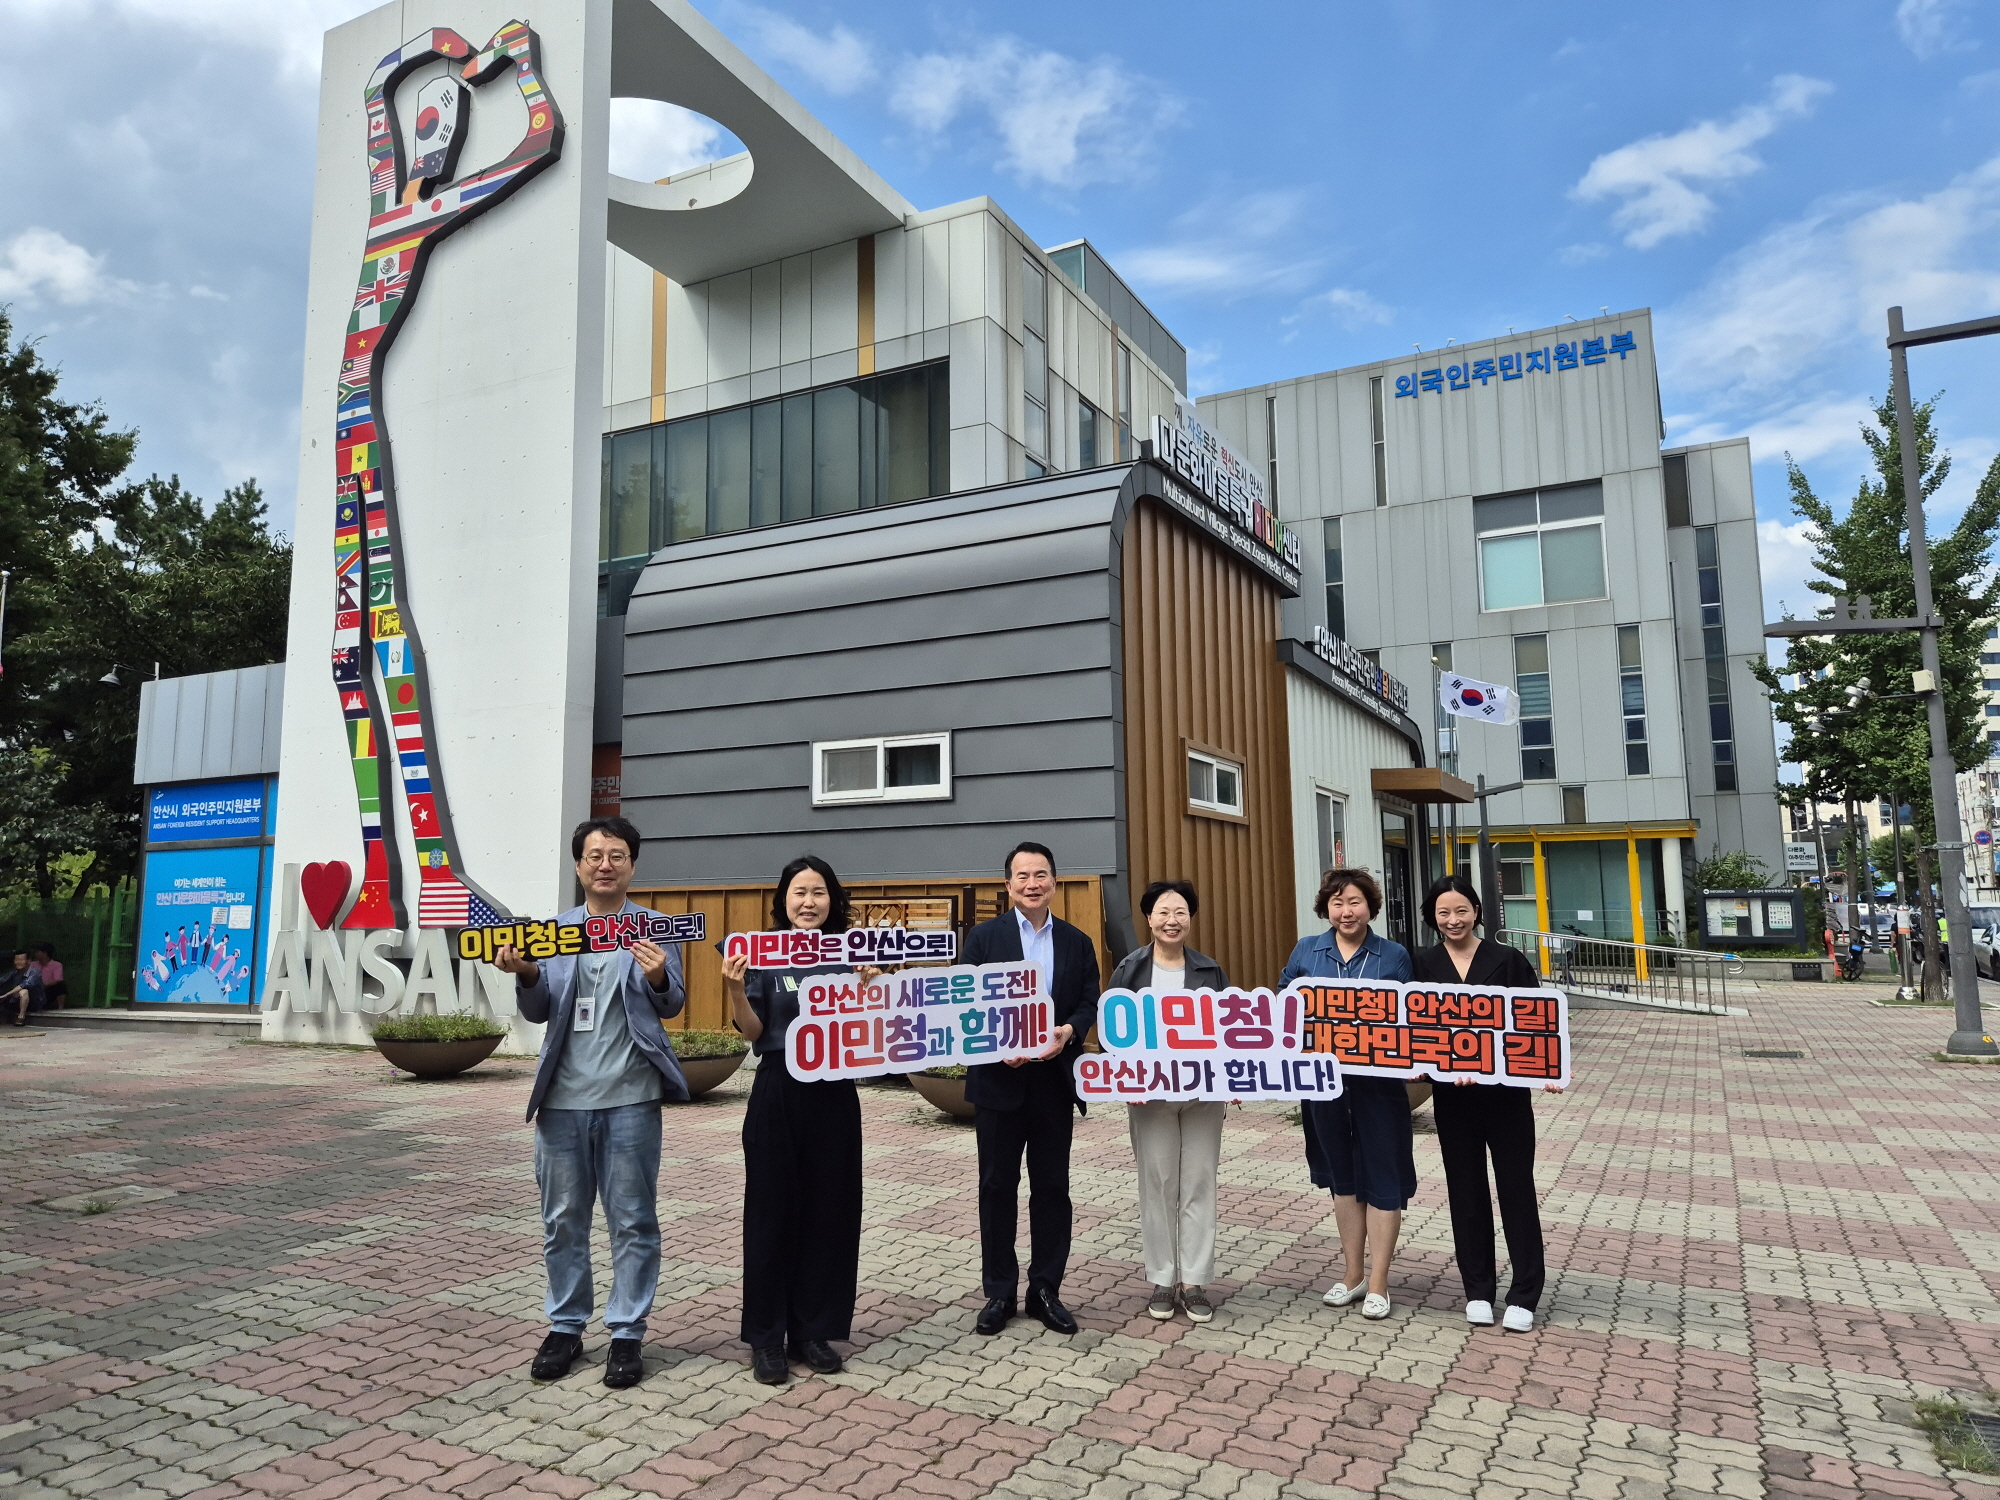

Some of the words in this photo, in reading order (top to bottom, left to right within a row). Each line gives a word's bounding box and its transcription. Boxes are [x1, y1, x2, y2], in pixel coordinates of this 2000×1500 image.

[1395, 331, 1637, 398] 외국인주민지원본부
[1187, 415, 1218, 461] 자유로운
[1221, 446, 1248, 489] 혁신도시
[1249, 473, 1263, 503] 안산
[1162, 476, 1206, 522] Multicultural
[1206, 508, 1228, 540] Village
[1229, 525, 1250, 553] Special
[1251, 541, 1266, 564] Zone
[1265, 553, 1281, 575] Media
[1281, 564, 1298, 589] Center
[153, 803, 179, 819] 안산시
[181, 797, 262, 817] 외국인주민지원본부
[167, 821, 185, 829] FOREIGN
[185, 820, 206, 828] RESIDENT
[206, 818, 225, 826] SUPPORT
[225, 816, 260, 825] HEADQUARTERS
[156, 892, 173, 906] 안산
[281, 863, 301, 931] I
[460, 921, 583, 962] 이민청은
[586, 913, 704, 951] 안산으로!
[728, 932, 843, 967] 이민청은
[847, 928, 953, 963] 안산으로!
[260, 928, 518, 1017] ANSAN
[808, 983, 891, 1016] 안산의
[896, 974, 976, 1007] 새로운
[982, 969, 1037, 1001] 도전!
[1103, 994, 1298, 1050] 이민청!
[1299, 987, 1397, 1021] 이민청!
[1407, 992, 1503, 1028] 안산의
[1513, 998, 1557, 1031] 길!
[795, 1013, 955, 1071] 이민청과
[959, 1002, 1048, 1054] 함께!
[1505, 1034, 1560, 1077] 길!
[1080, 1059, 1216, 1094] 안산시가
[1223, 1058, 1336, 1093] 합니다!
